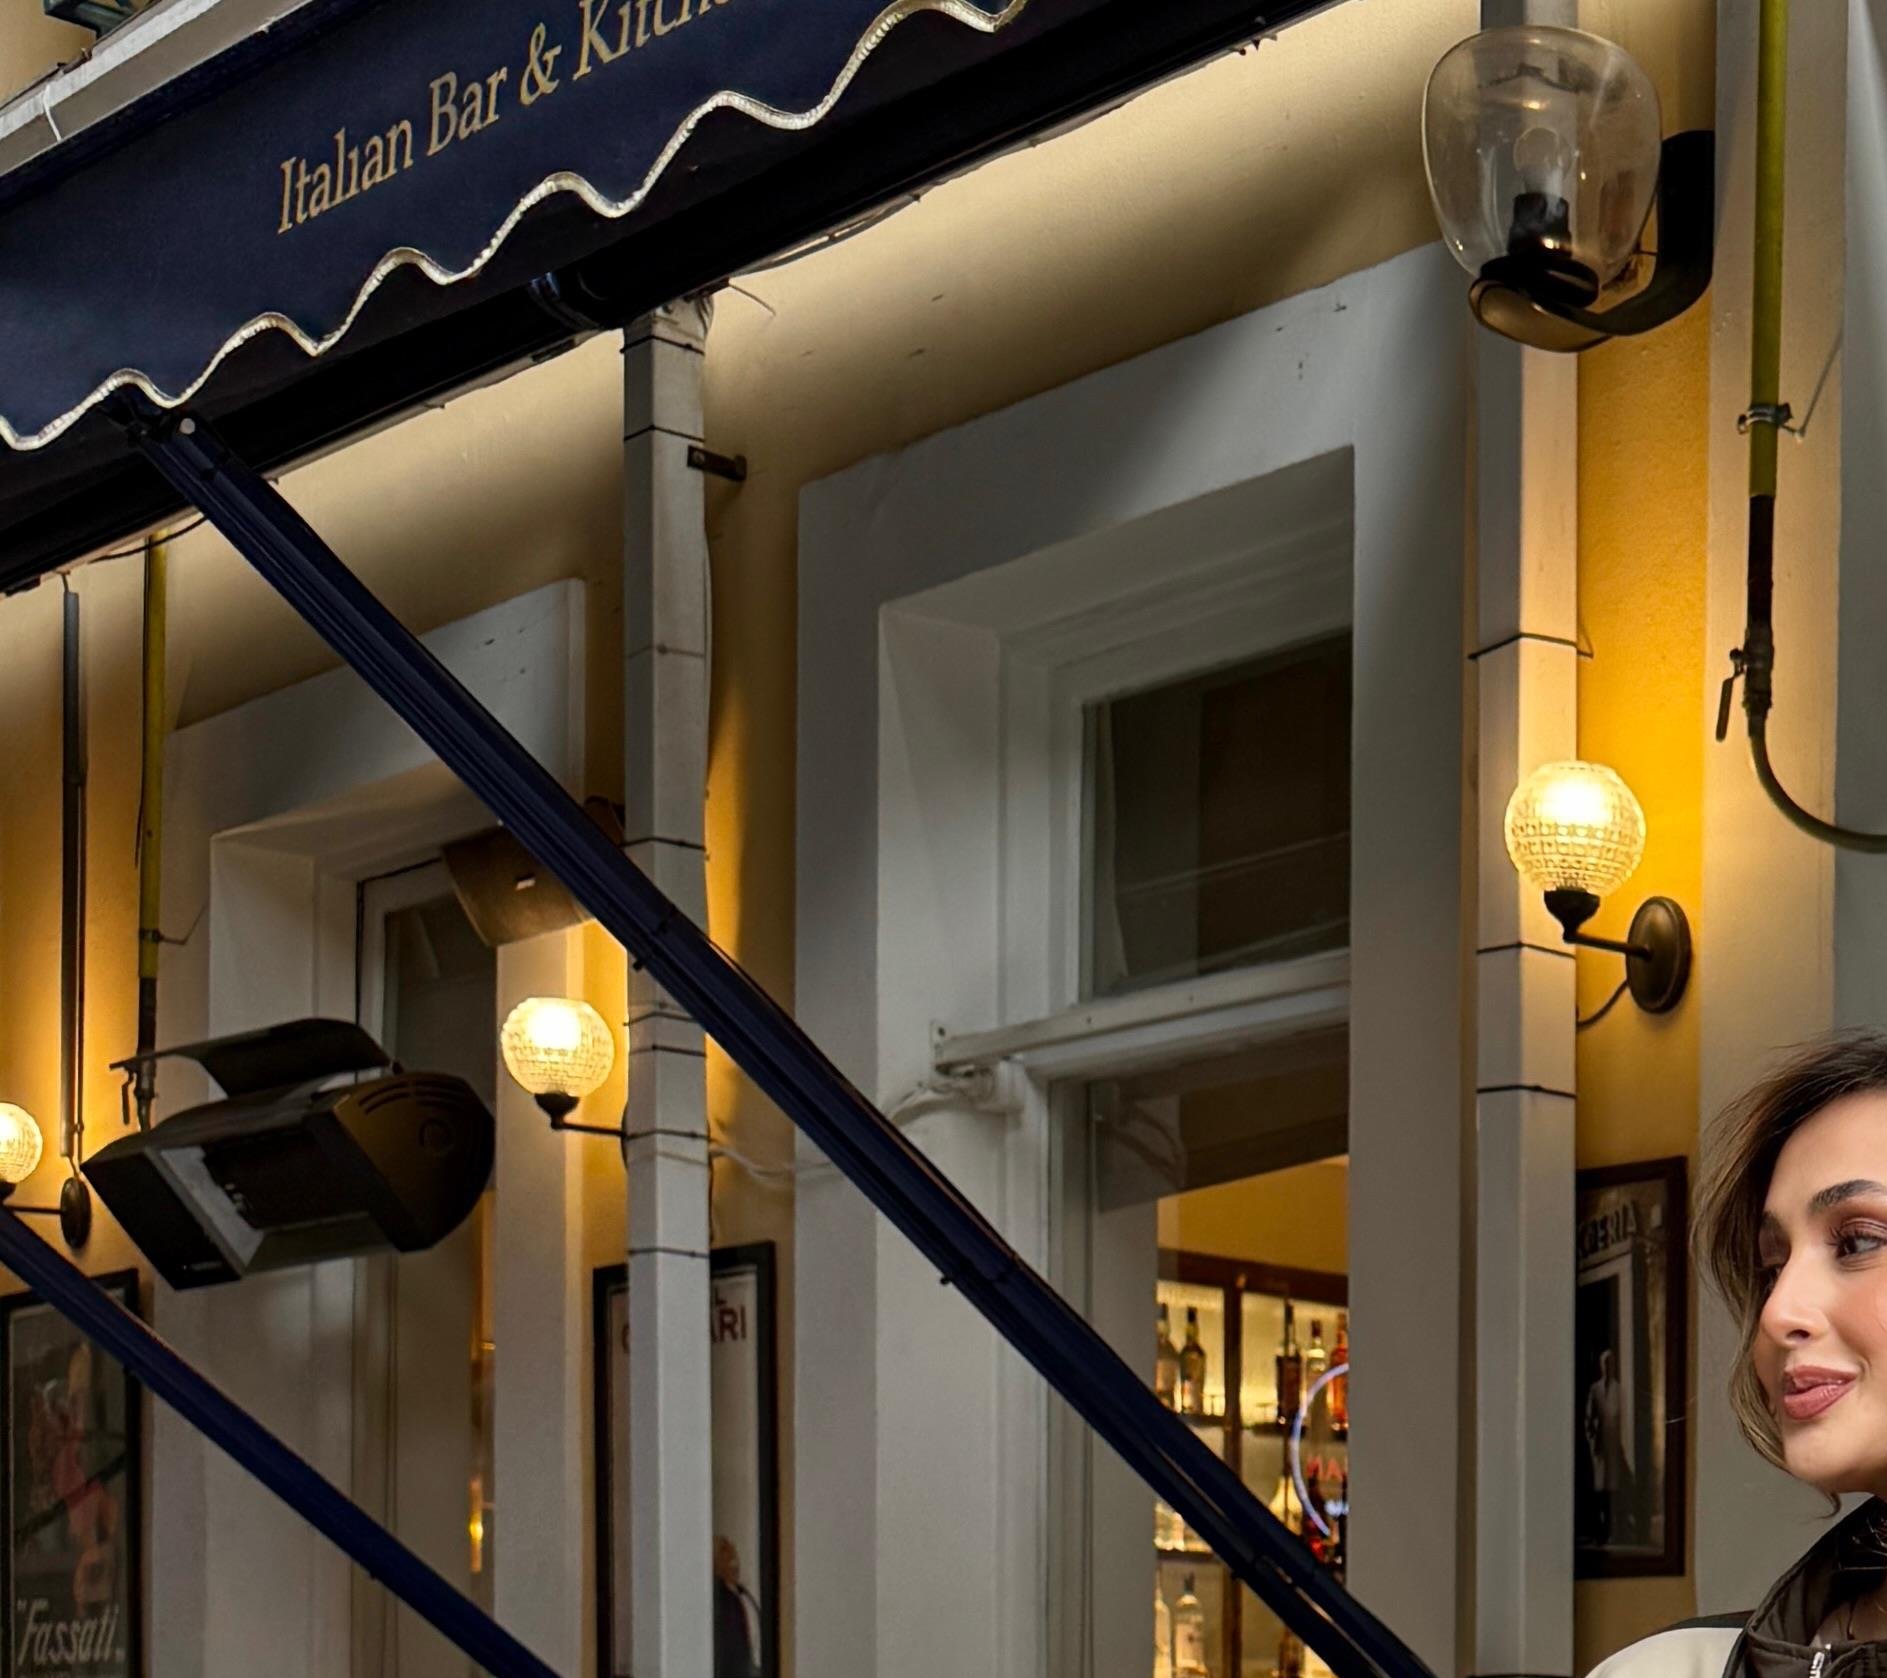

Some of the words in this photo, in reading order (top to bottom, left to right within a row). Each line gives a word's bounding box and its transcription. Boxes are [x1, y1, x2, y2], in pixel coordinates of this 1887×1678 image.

[277, 119, 413, 235] Italian
[426, 66, 508, 157] Bar
[519, 24, 561, 106] &
